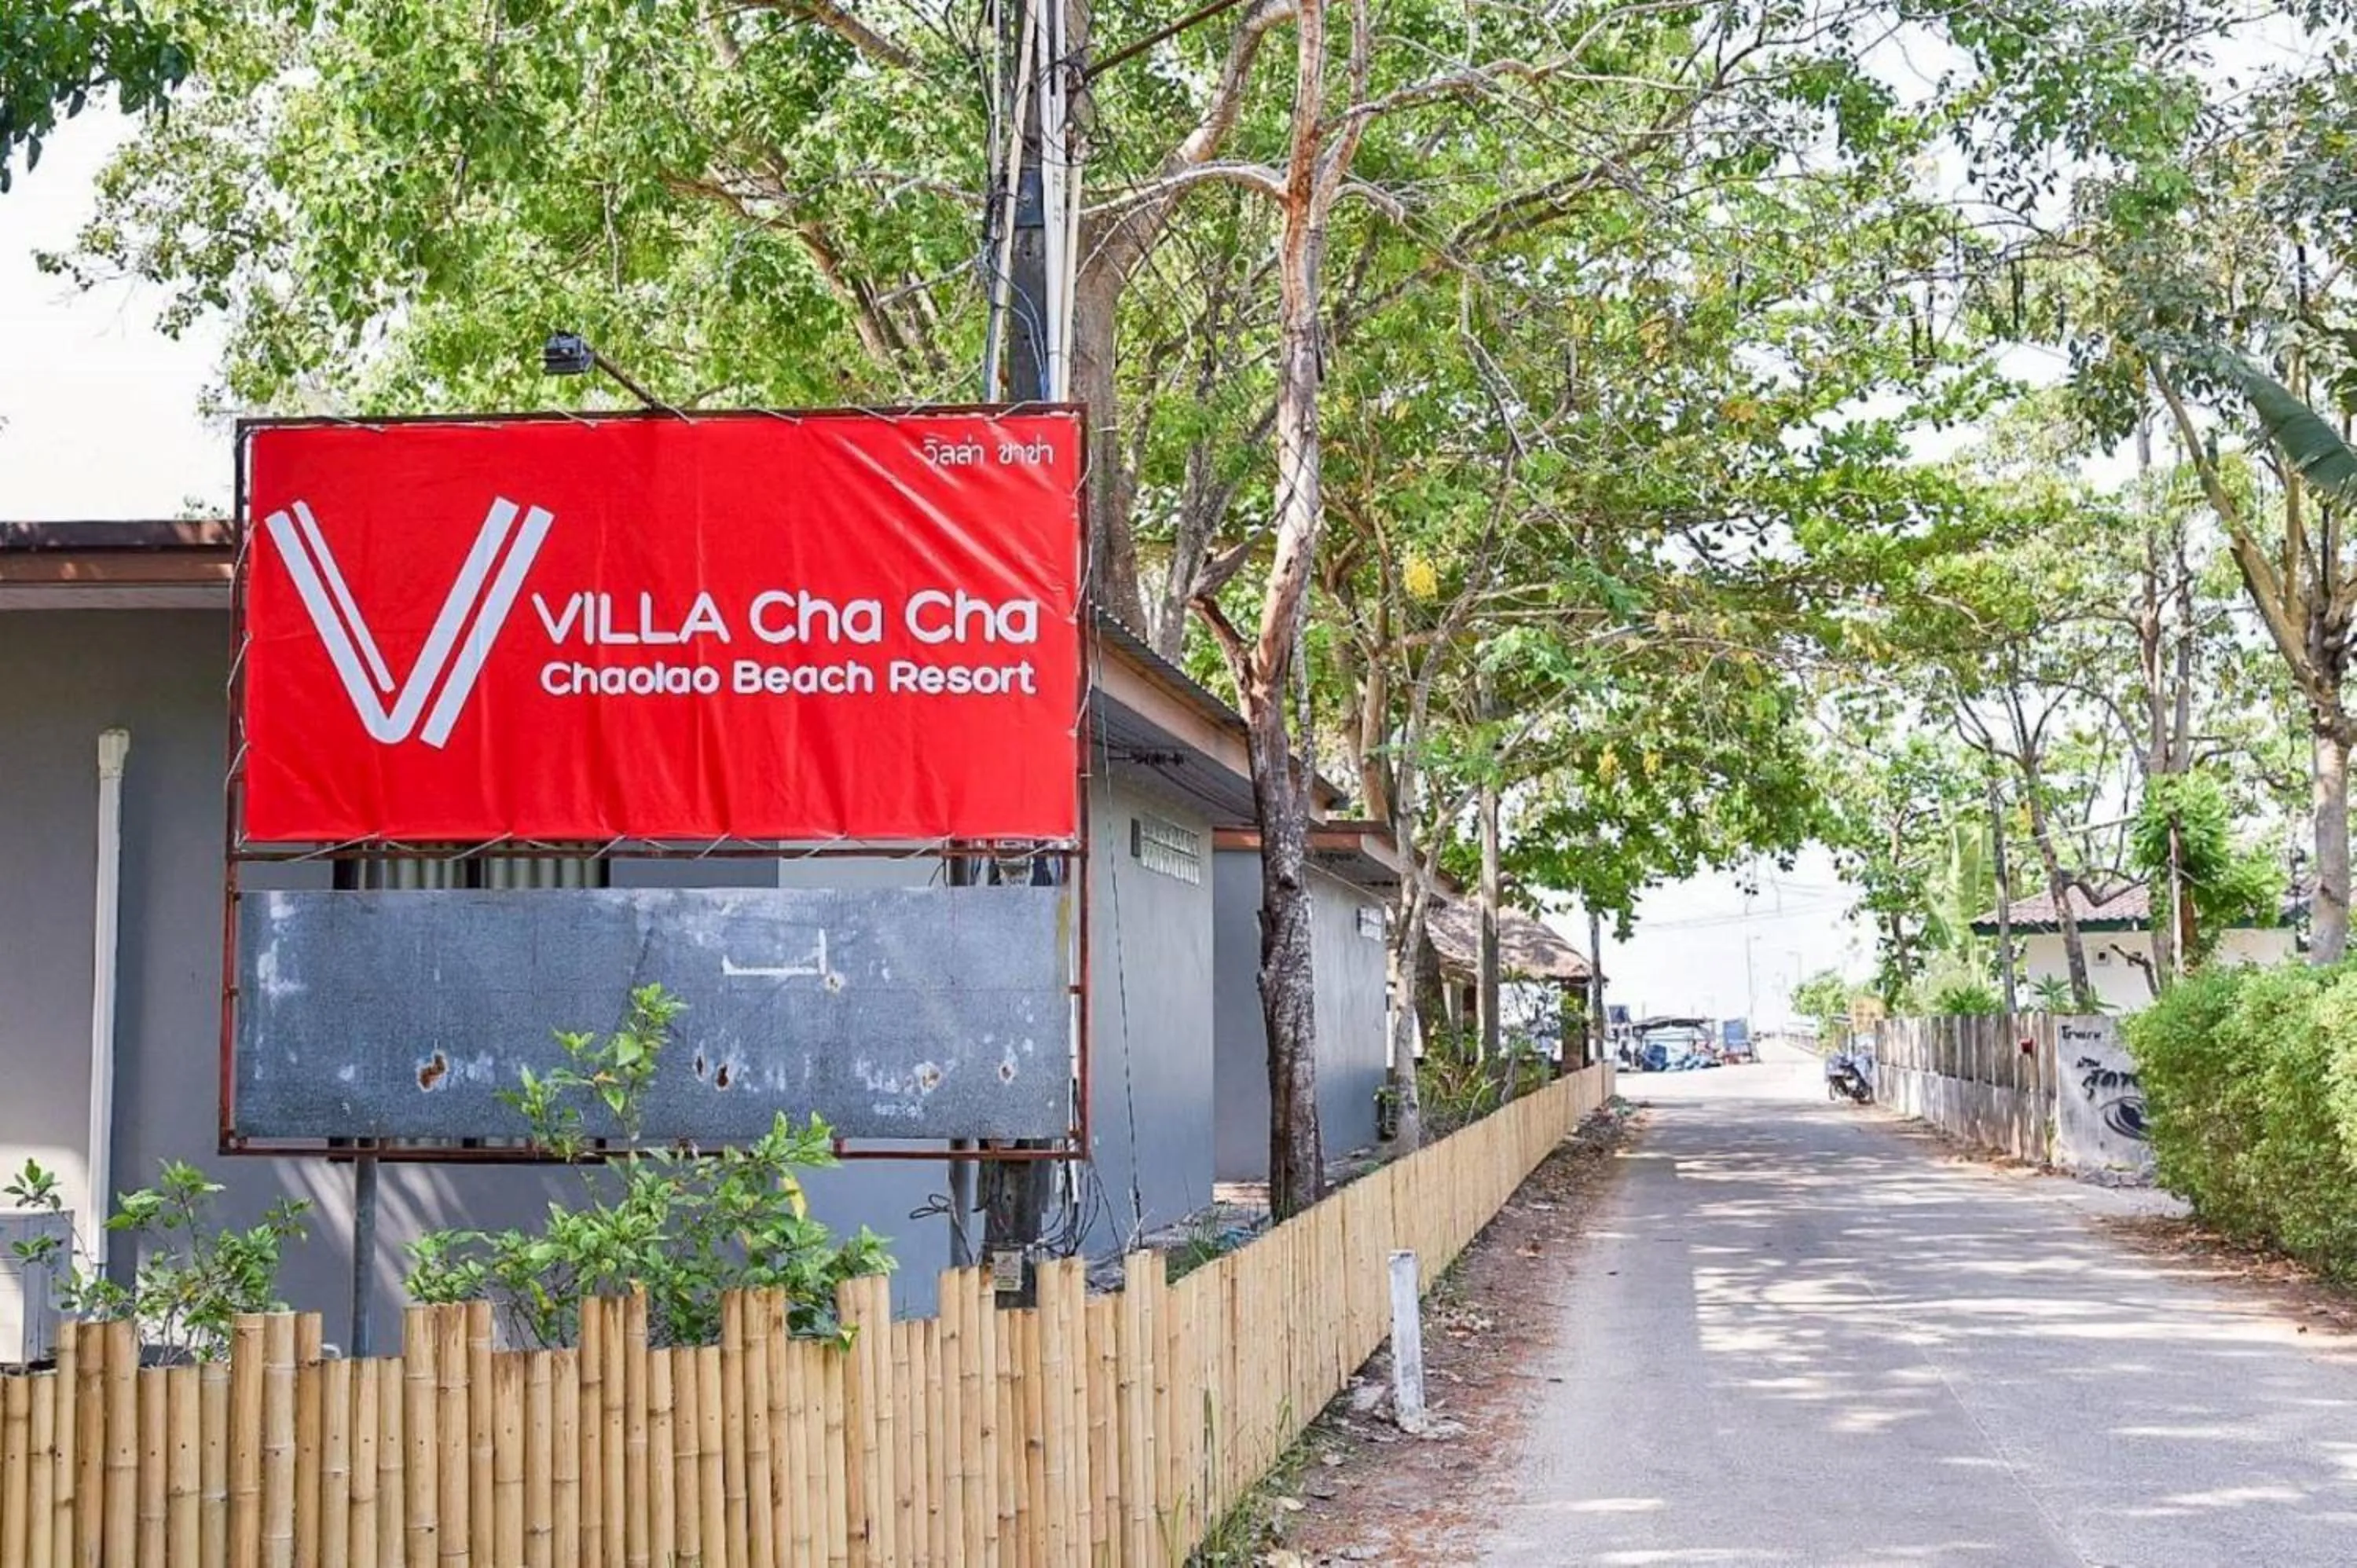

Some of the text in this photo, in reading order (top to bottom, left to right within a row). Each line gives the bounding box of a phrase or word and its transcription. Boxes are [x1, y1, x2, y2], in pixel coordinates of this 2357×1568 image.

[922, 434, 984, 466] วิลล่า
[532, 589, 1040, 644] VILLA Cha Cha
[540, 660, 1037, 695] Chaolao Beach Resort
